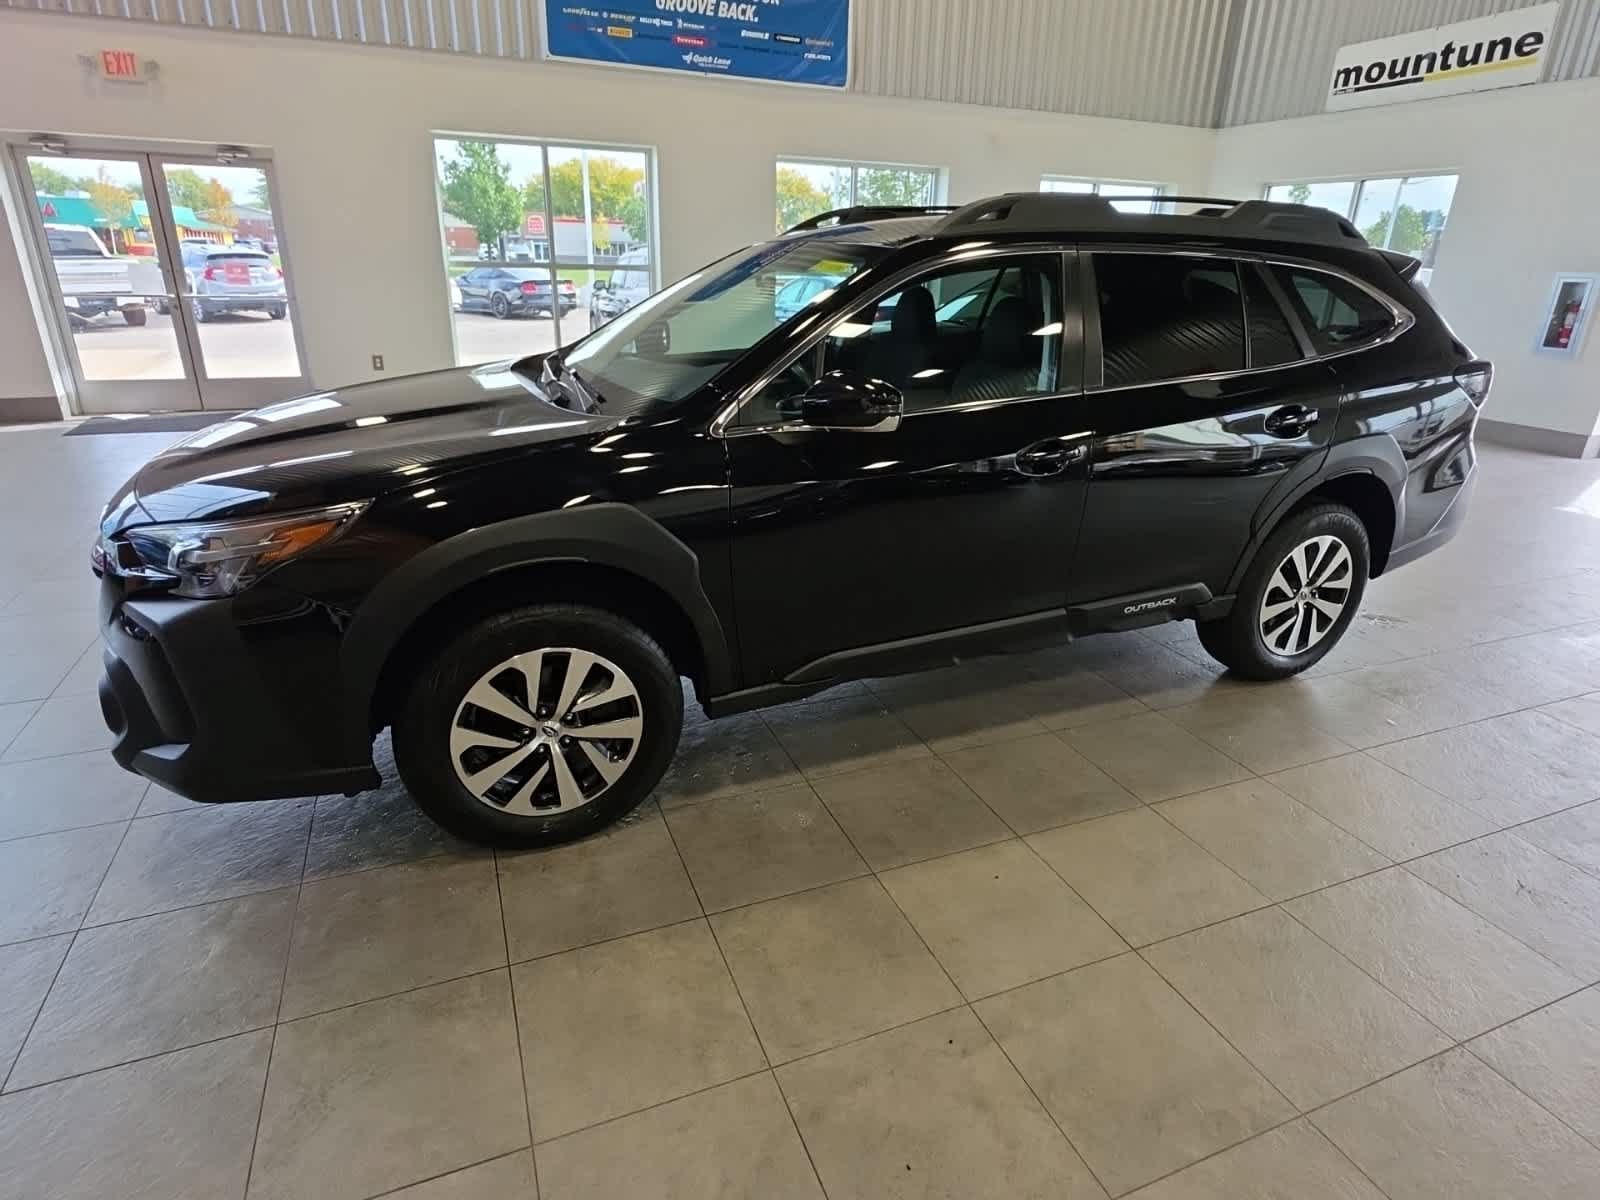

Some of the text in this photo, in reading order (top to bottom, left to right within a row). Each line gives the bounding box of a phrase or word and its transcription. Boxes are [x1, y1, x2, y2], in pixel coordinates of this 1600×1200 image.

[655, 0, 759, 22] GROOVE BACK.
[102, 50, 137, 77] EXIT
[1332, 31, 1544, 90] mountune
[1124, 597, 1177, 614] OUTBACK
